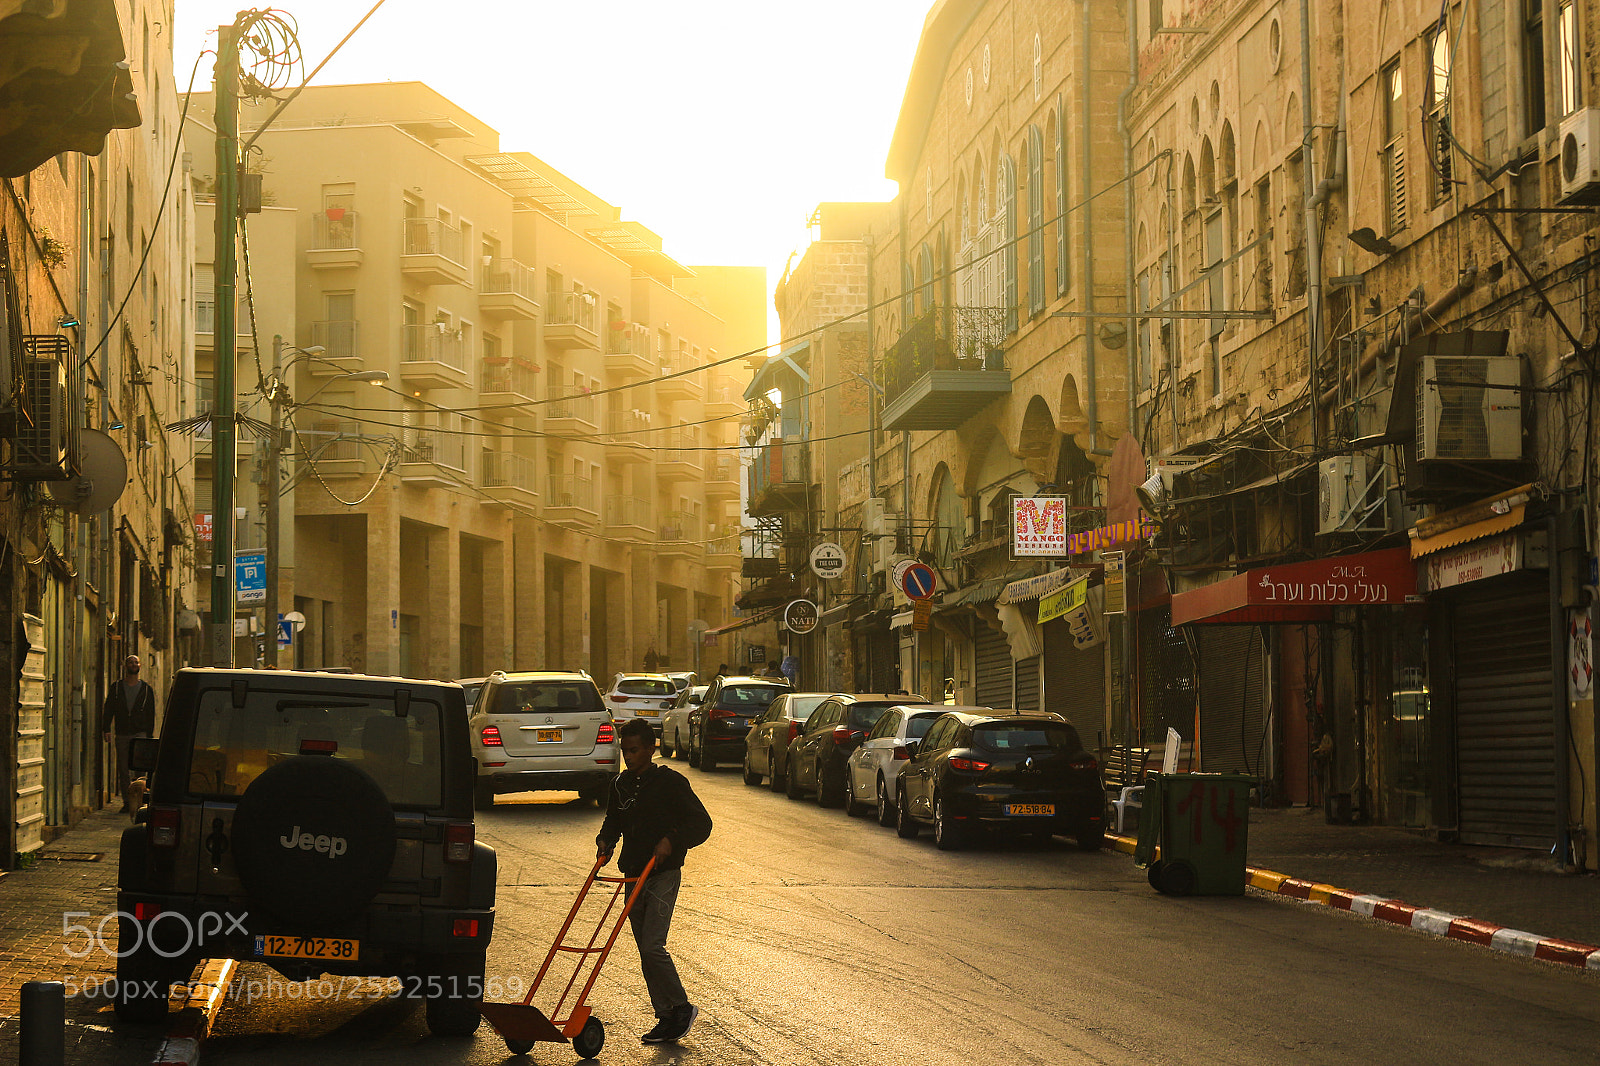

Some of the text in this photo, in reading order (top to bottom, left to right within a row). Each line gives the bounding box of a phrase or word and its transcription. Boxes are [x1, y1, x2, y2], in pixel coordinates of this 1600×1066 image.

[1015, 499, 1065, 535] M
[1017, 534, 1065, 542] MANGO
[1332, 566, 1368, 579] M.A.
[241, 591, 264, 599] pango
[1265, 582, 1304, 602] וערב
[1309, 580, 1349, 602] כלות
[1353, 580, 1389, 602] נעלי
[791, 617, 815, 625] NATI
[1176, 780, 1243, 853] 14
[279, 825, 348, 859] Jeep
